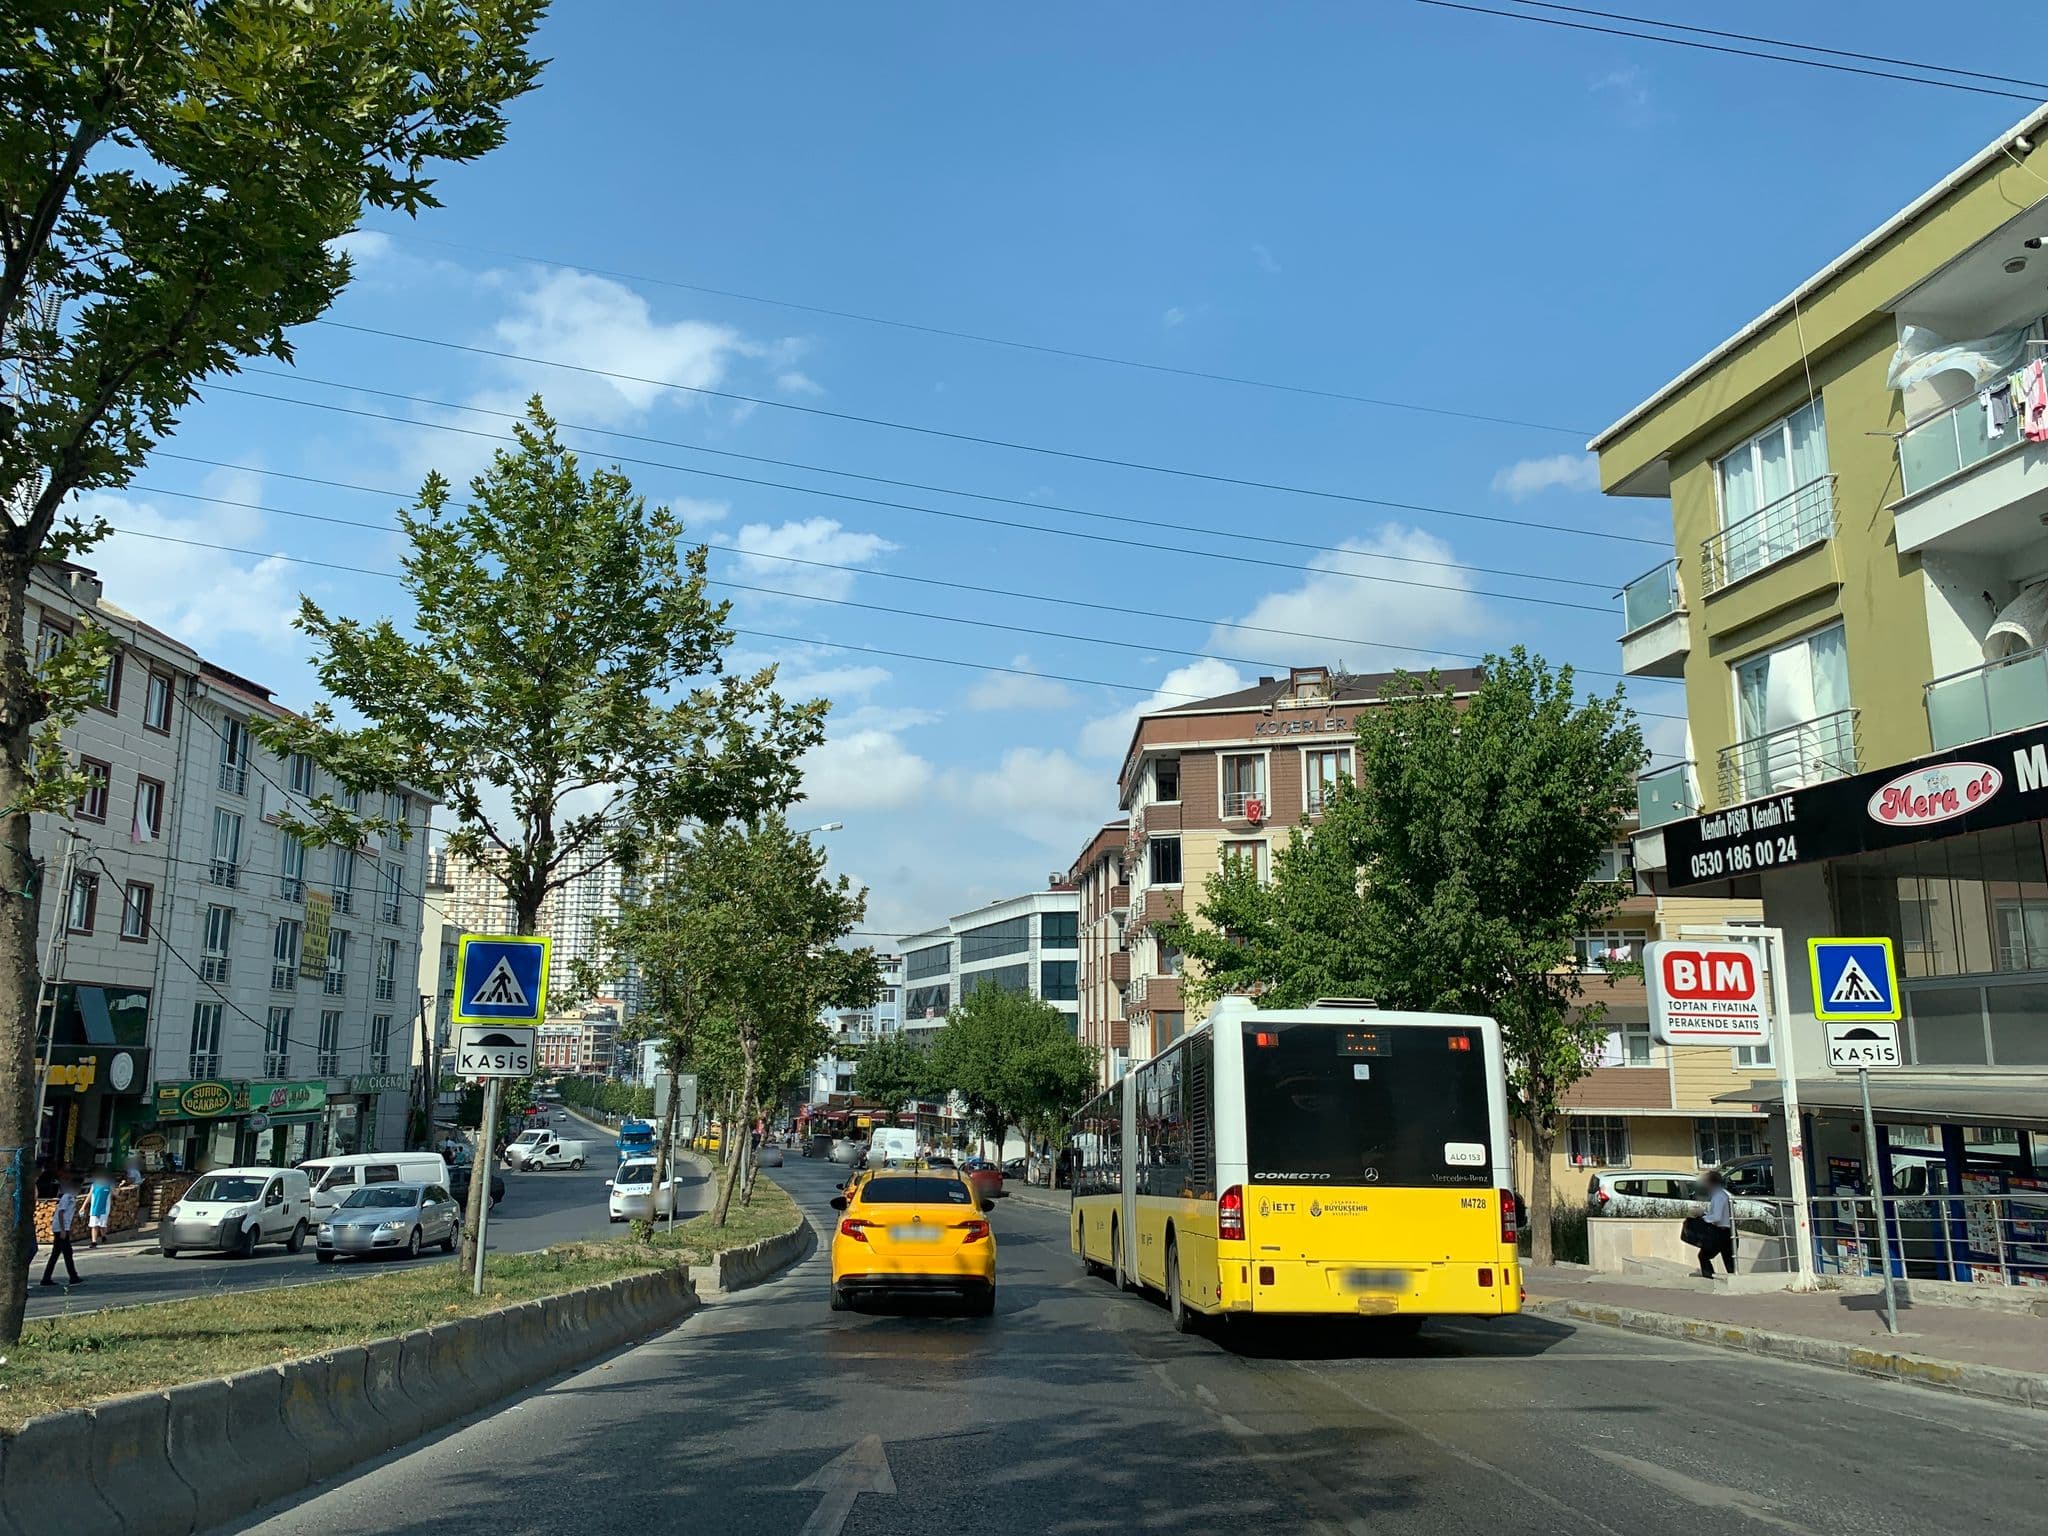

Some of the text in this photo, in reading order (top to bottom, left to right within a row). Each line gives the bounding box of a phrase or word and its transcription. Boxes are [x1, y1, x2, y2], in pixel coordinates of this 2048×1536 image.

[1879, 771, 1993, 820] Mera et
[1700, 815, 1727, 841] Kendin
[1751, 802, 1781, 830] Kendin
[1781, 797, 1796, 823] YE
[1691, 835, 1797, 878] 0530 186 00 24
[1668, 1001, 1708, 1011] TOPTAN
[1668, 1017, 1759, 1031] PERAKENDE SATIŞ
[1832, 1044, 1895, 1061] KASİS
[462, 1051, 528, 1069] KASİS
[1450, 1153, 1481, 1161] ALO 153
[1254, 1172, 1331, 1180] CONECTO
[1432, 1173, 1489, 1183] Mercedes-Benz
[1460, 1197, 1487, 1209] M4728
